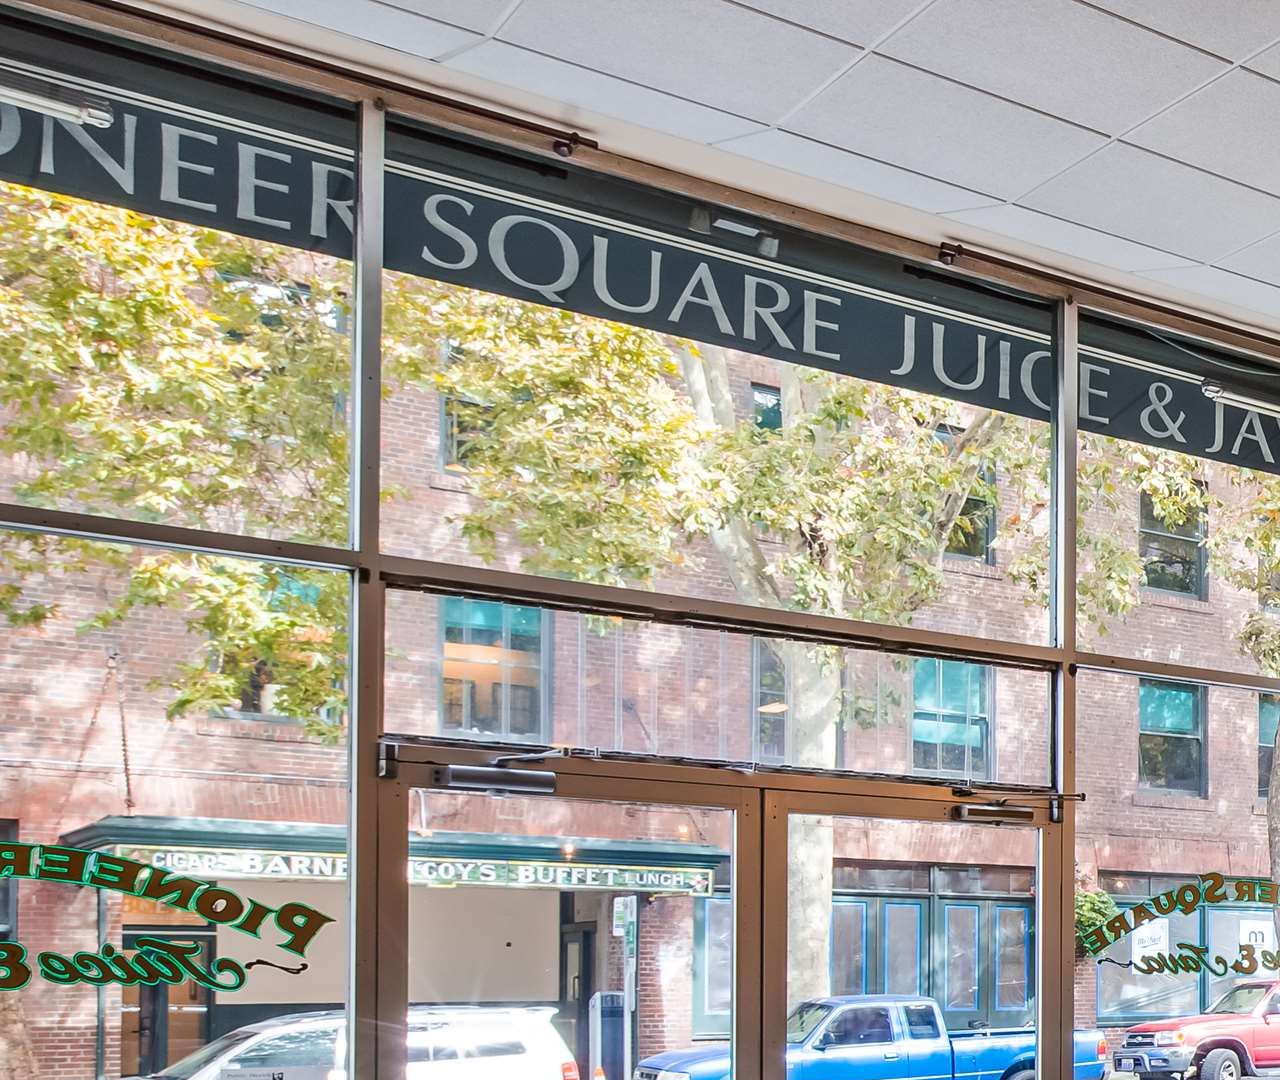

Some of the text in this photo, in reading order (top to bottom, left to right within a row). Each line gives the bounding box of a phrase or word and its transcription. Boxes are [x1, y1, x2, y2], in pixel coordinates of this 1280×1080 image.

[0, 104, 354, 238] NEER
[422, 193, 841, 361] SQUARE
[889, 314, 1110, 425] JUICE
[1139, 382, 1187, 443] &
[517, 863, 619, 887] BUFFET
[623, 871, 684, 886] LUNCH
